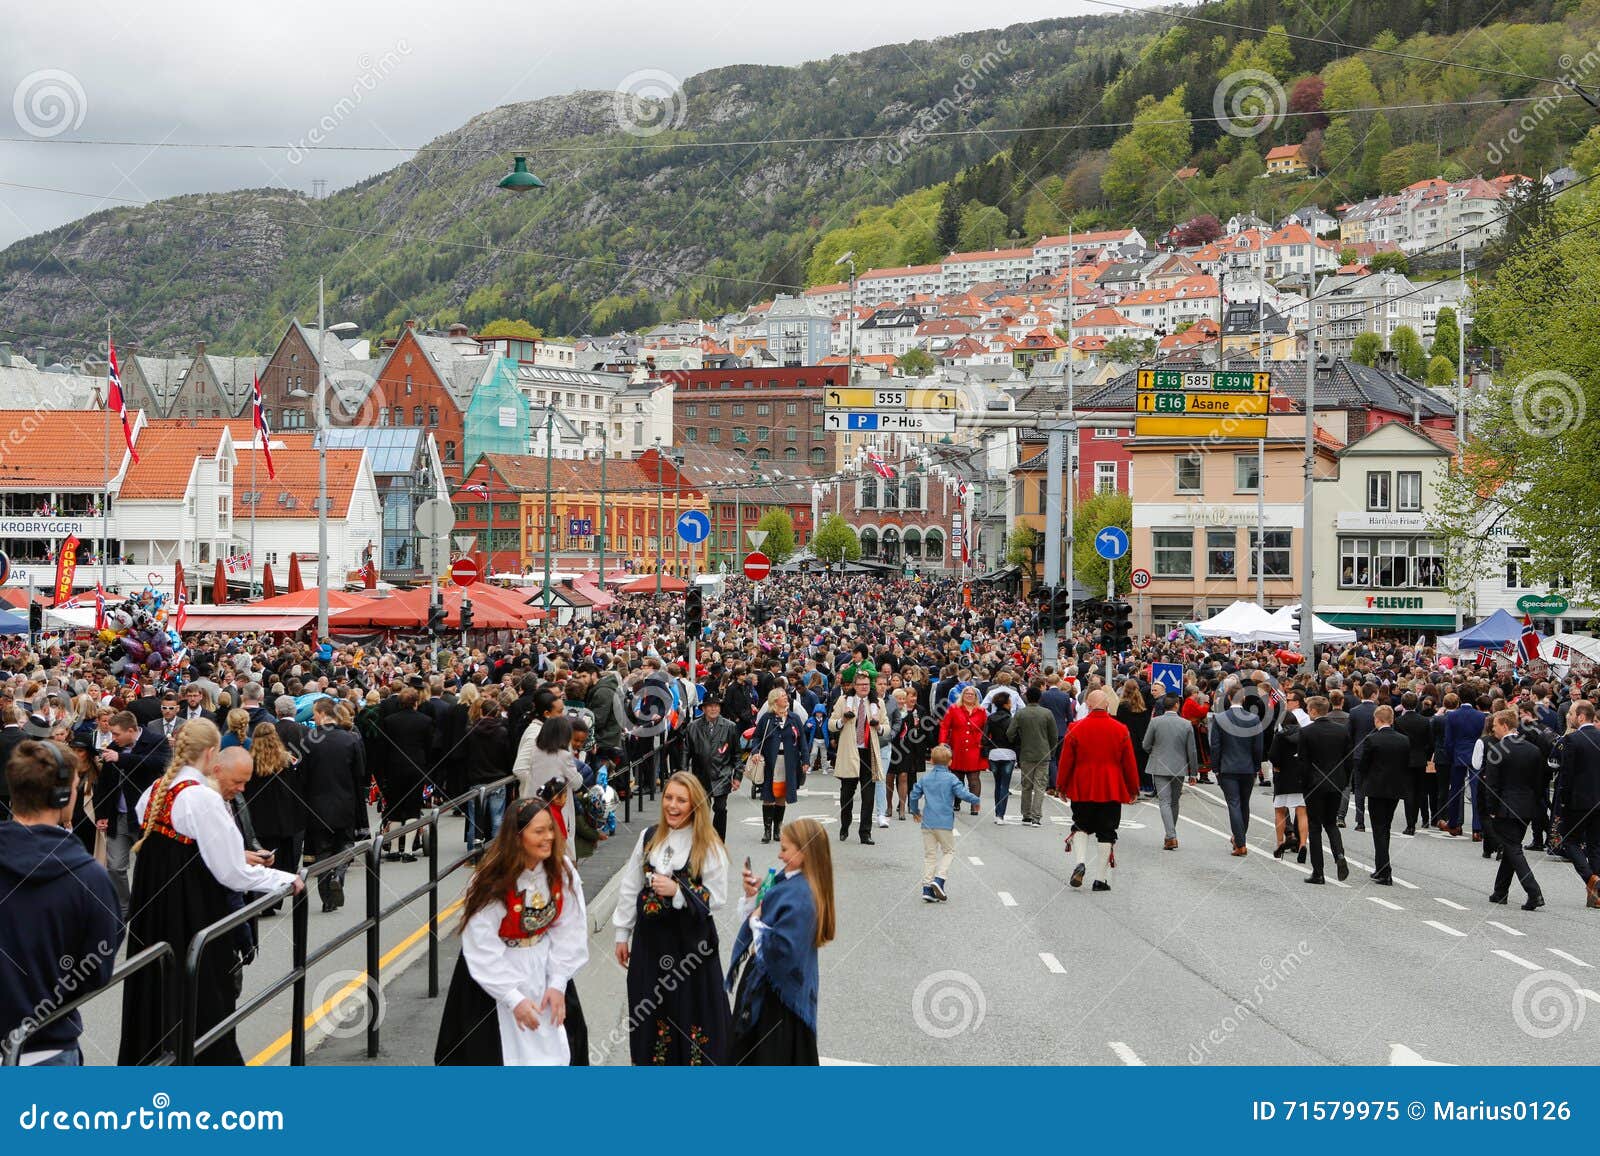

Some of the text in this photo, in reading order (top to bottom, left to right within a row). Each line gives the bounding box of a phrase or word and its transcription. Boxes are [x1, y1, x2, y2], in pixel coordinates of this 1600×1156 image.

[1157, 375, 1178, 385] E 16
[1187, 376, 1208, 386] 585
[1217, 377, 1250, 387] E 39 N
[879, 393, 902, 404] 555
[1159, 398, 1181, 408] E 16
[1192, 395, 1230, 409] Åsane
[858, 416, 868, 428] P
[882, 416, 923, 427] P-Hus
[1, 522, 82, 532] KROBRYGGERI
[60, 542, 75, 600] POPCORN
[1134, 573, 1147, 584] 30
